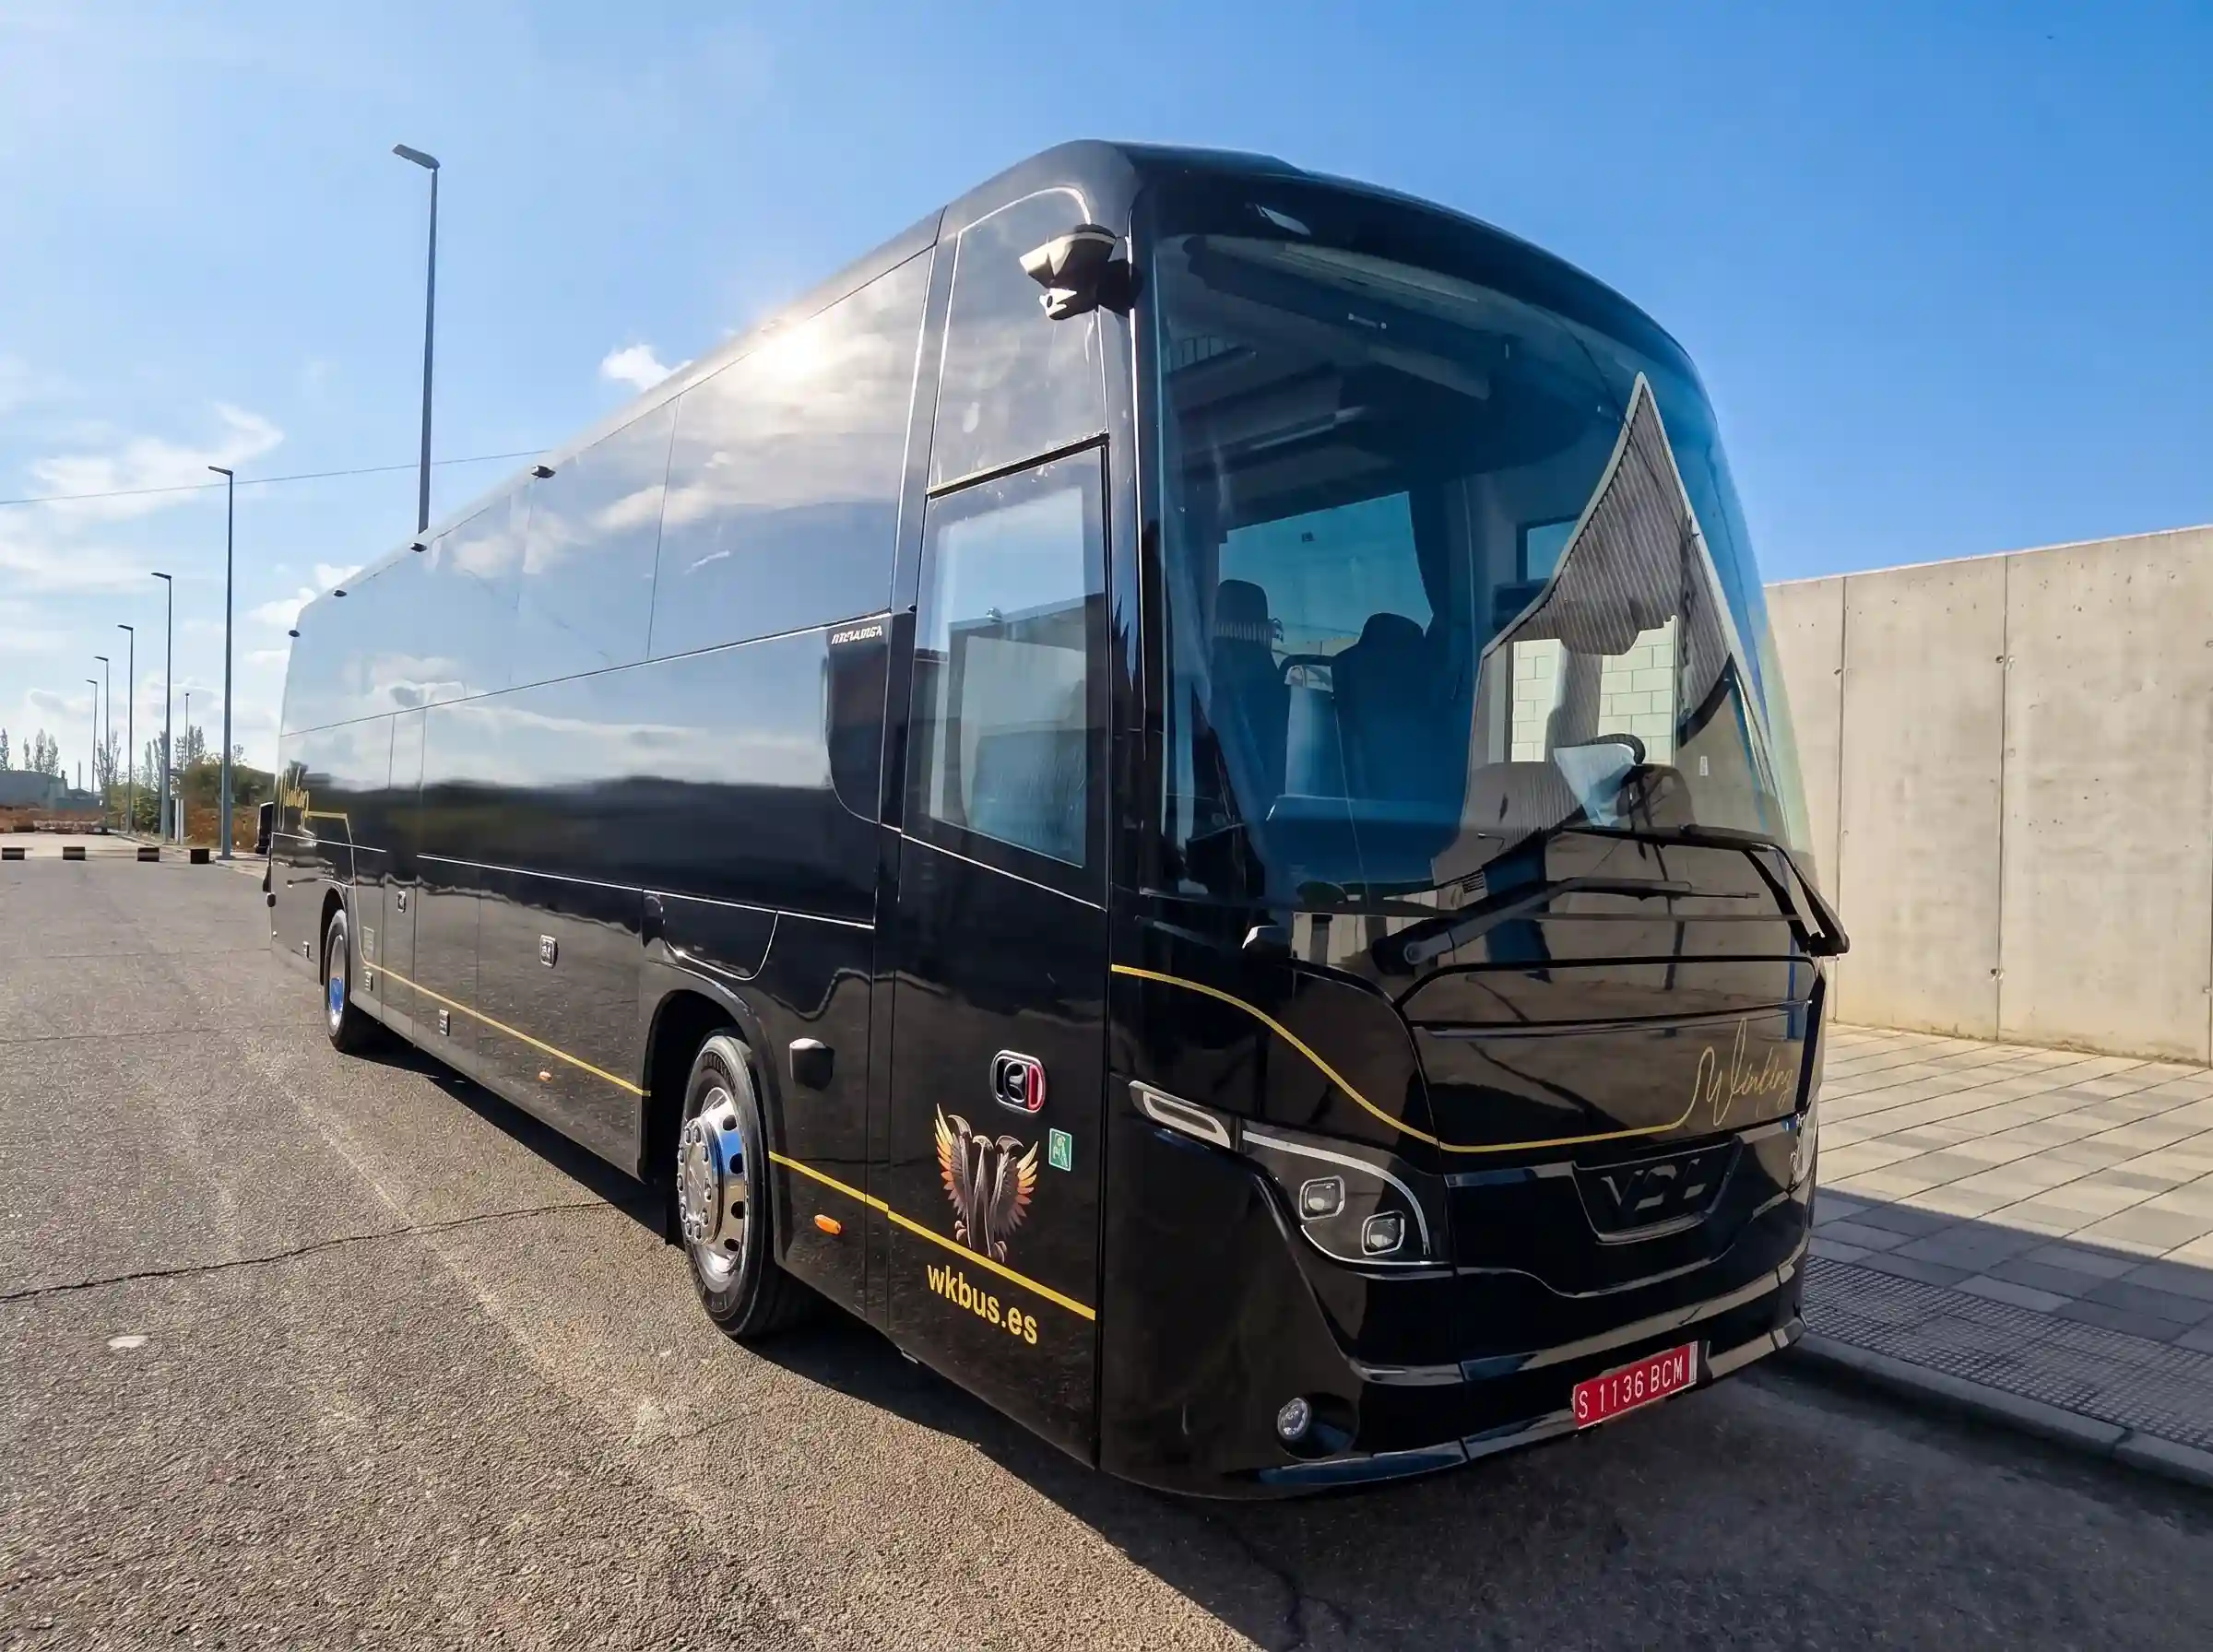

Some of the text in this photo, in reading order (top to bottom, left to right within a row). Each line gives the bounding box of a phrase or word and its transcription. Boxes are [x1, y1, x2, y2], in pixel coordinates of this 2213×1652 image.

[928, 1264, 1037, 1345] wkbus.es
[1599, 1370, 1644, 1413] 1136
[1650, 1354, 1684, 1393] BCM
